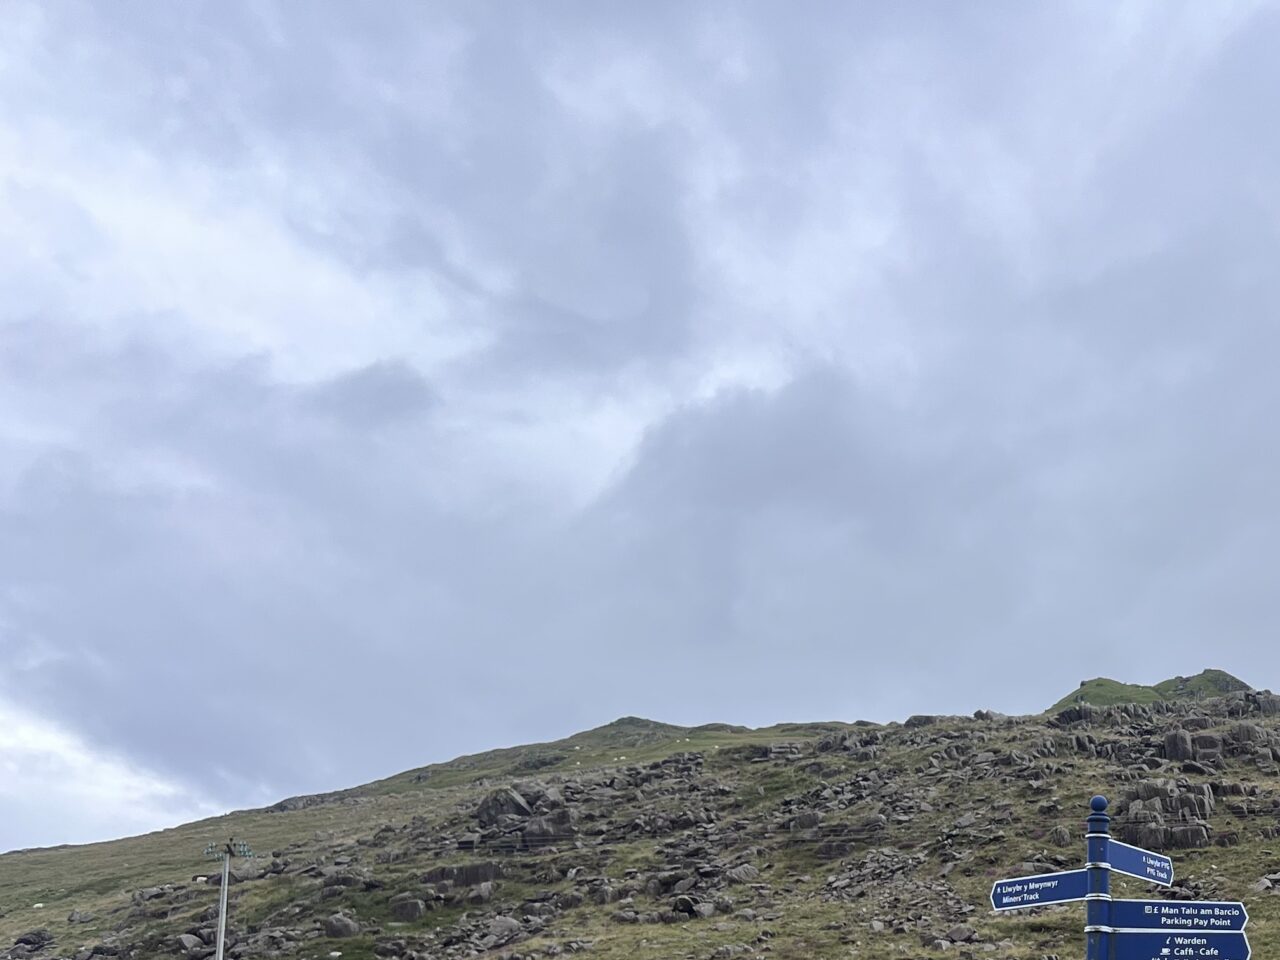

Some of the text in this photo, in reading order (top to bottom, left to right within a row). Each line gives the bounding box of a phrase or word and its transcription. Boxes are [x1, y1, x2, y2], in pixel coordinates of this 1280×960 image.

[1002, 884, 1023, 894] Llwybr
[1028, 880, 1059, 890] Mwynwyr
[1023, 892, 1040, 901] Track
[1181, 907, 1198, 915] Talu
[1214, 908, 1240, 916] Barcio
[1161, 917, 1231, 927] Parking Pay Point
[1174, 937, 1207, 945] Warden
[1199, 948, 1219, 956] Cafe
